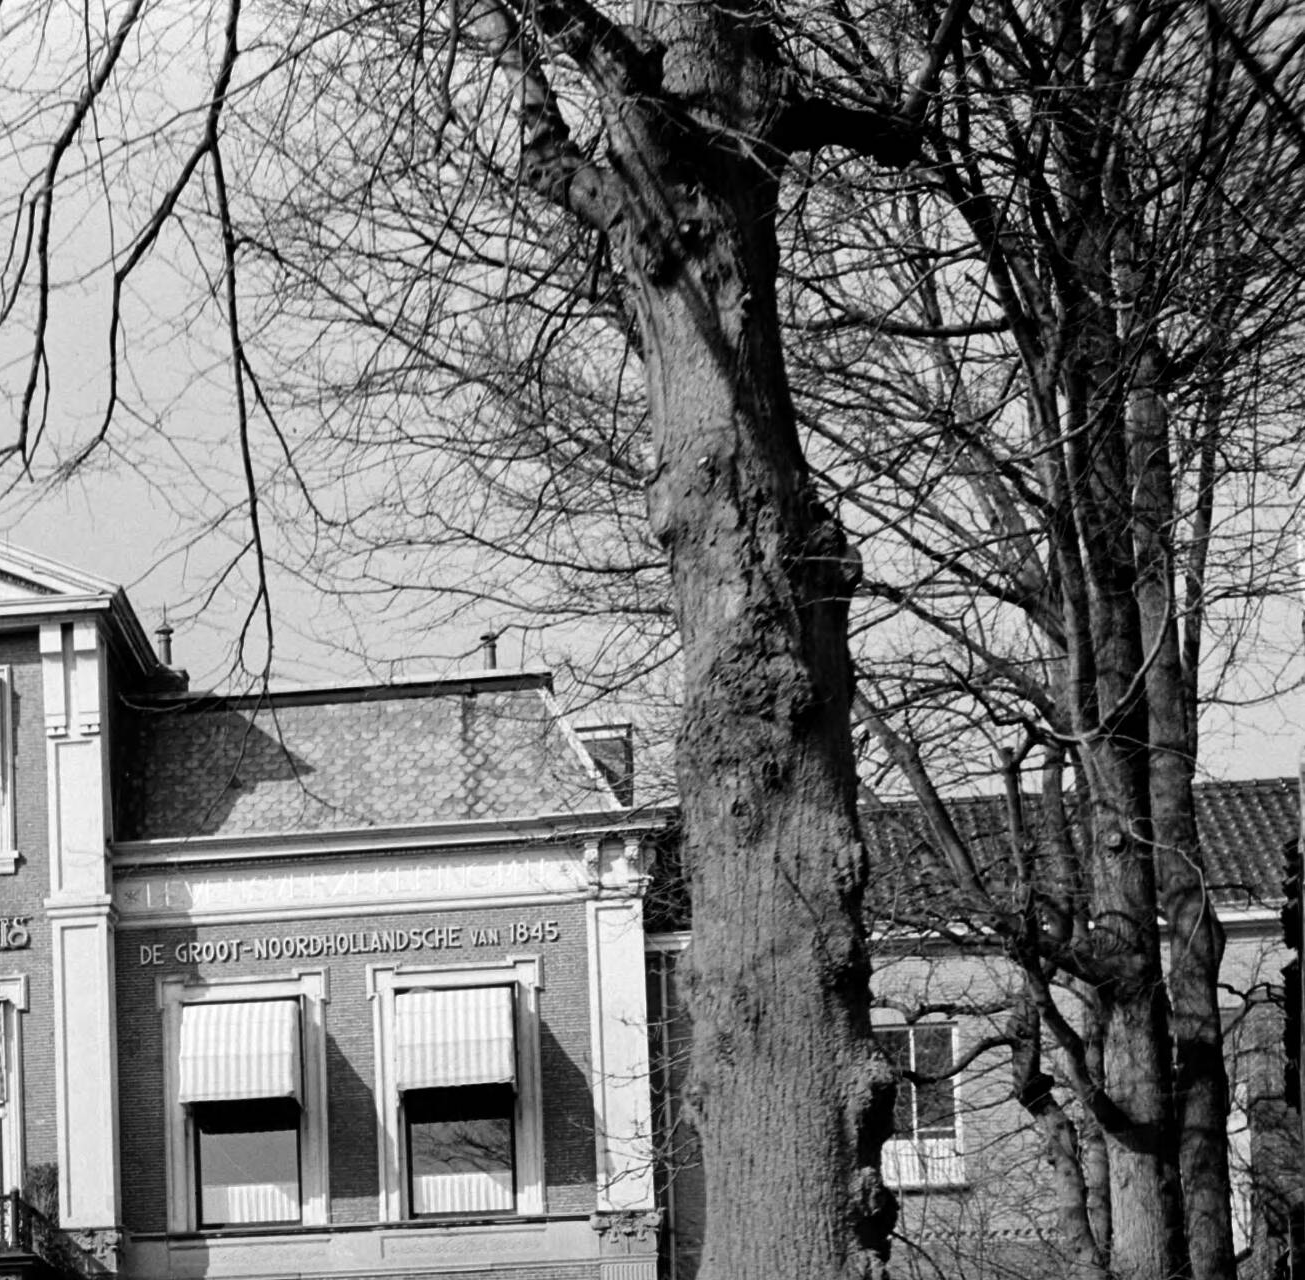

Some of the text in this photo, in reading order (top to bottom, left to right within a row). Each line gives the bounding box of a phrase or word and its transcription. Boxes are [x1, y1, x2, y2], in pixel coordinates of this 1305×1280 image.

[140, 920, 560, 965] DE GROOT-NOORDHOLLANDSCHE VAN 1845
